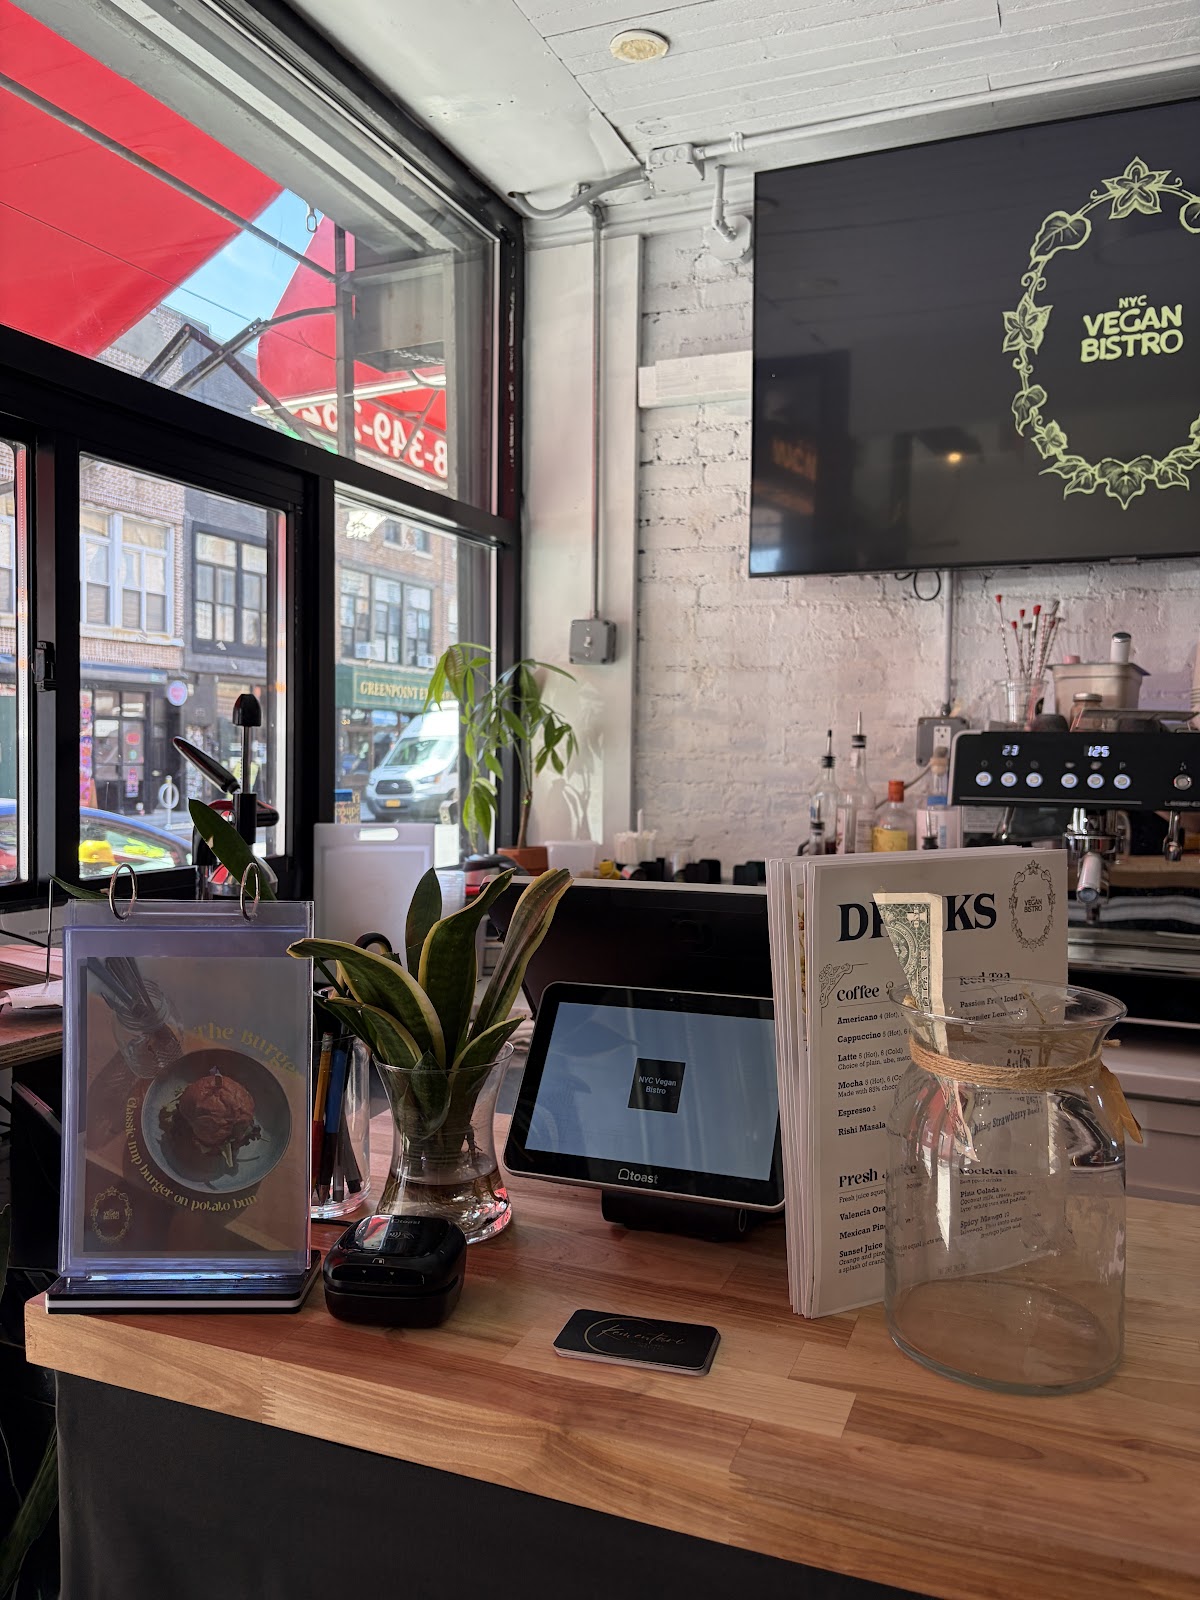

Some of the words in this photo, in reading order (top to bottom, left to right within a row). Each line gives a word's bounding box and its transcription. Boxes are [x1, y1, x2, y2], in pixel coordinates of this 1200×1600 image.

[1118, 294, 1147, 308] NYC
[1083, 304, 1183, 337] VEGAN
[1080, 329, 1184, 362] BISTRO
[360, 681, 417, 700] GREENPOINT
[1001, 744, 1020, 756] 23
[1088, 745, 1110, 757] 125
[1024, 898, 1043, 906] VEGAN
[836, 893, 997, 943] DKS
[837, 1012, 878, 1025] Americano
[837, 1030, 882, 1044] Cappuccino
[837, 1053, 857, 1062] Latte
[885, 1047, 904, 1056] (Cold)
[837, 1061, 858, 1071] Choice
[859, 1060, 866, 1068] of
[638, 1075, 654, 1084] NYC
[655, 1077, 677, 1087] Vegan
[837, 1079, 864, 1090] Mocha
[645, 1086, 667, 1095] Bistro
[837, 1090, 854, 1098] Made
[838, 1106, 871, 1118] Espresso
[838, 1126, 858, 1136] Rishi
[859, 1122, 886, 1132] Masala
[629, 1170, 659, 1184] toast
[838, 1168, 878, 1188] Fresh
[139, 1164, 174, 1198] burger
[174, 1194, 189, 1206] on
[190, 1199, 231, 1212] potato
[233, 1194, 257, 1209] bun
[839, 1194, 855, 1203] Fresh
[839, 1208, 871, 1221] Valencia
[839, 1227, 871, 1240] Mexican
[839, 1246, 863, 1258] Sunset
[864, 1242, 883, 1254] Juice
[838, 1255, 860, 1266] Orange
[860, 1253, 872, 1261] and
[842, 1263, 861, 1274] splash
[861, 1260, 868, 1268] of
